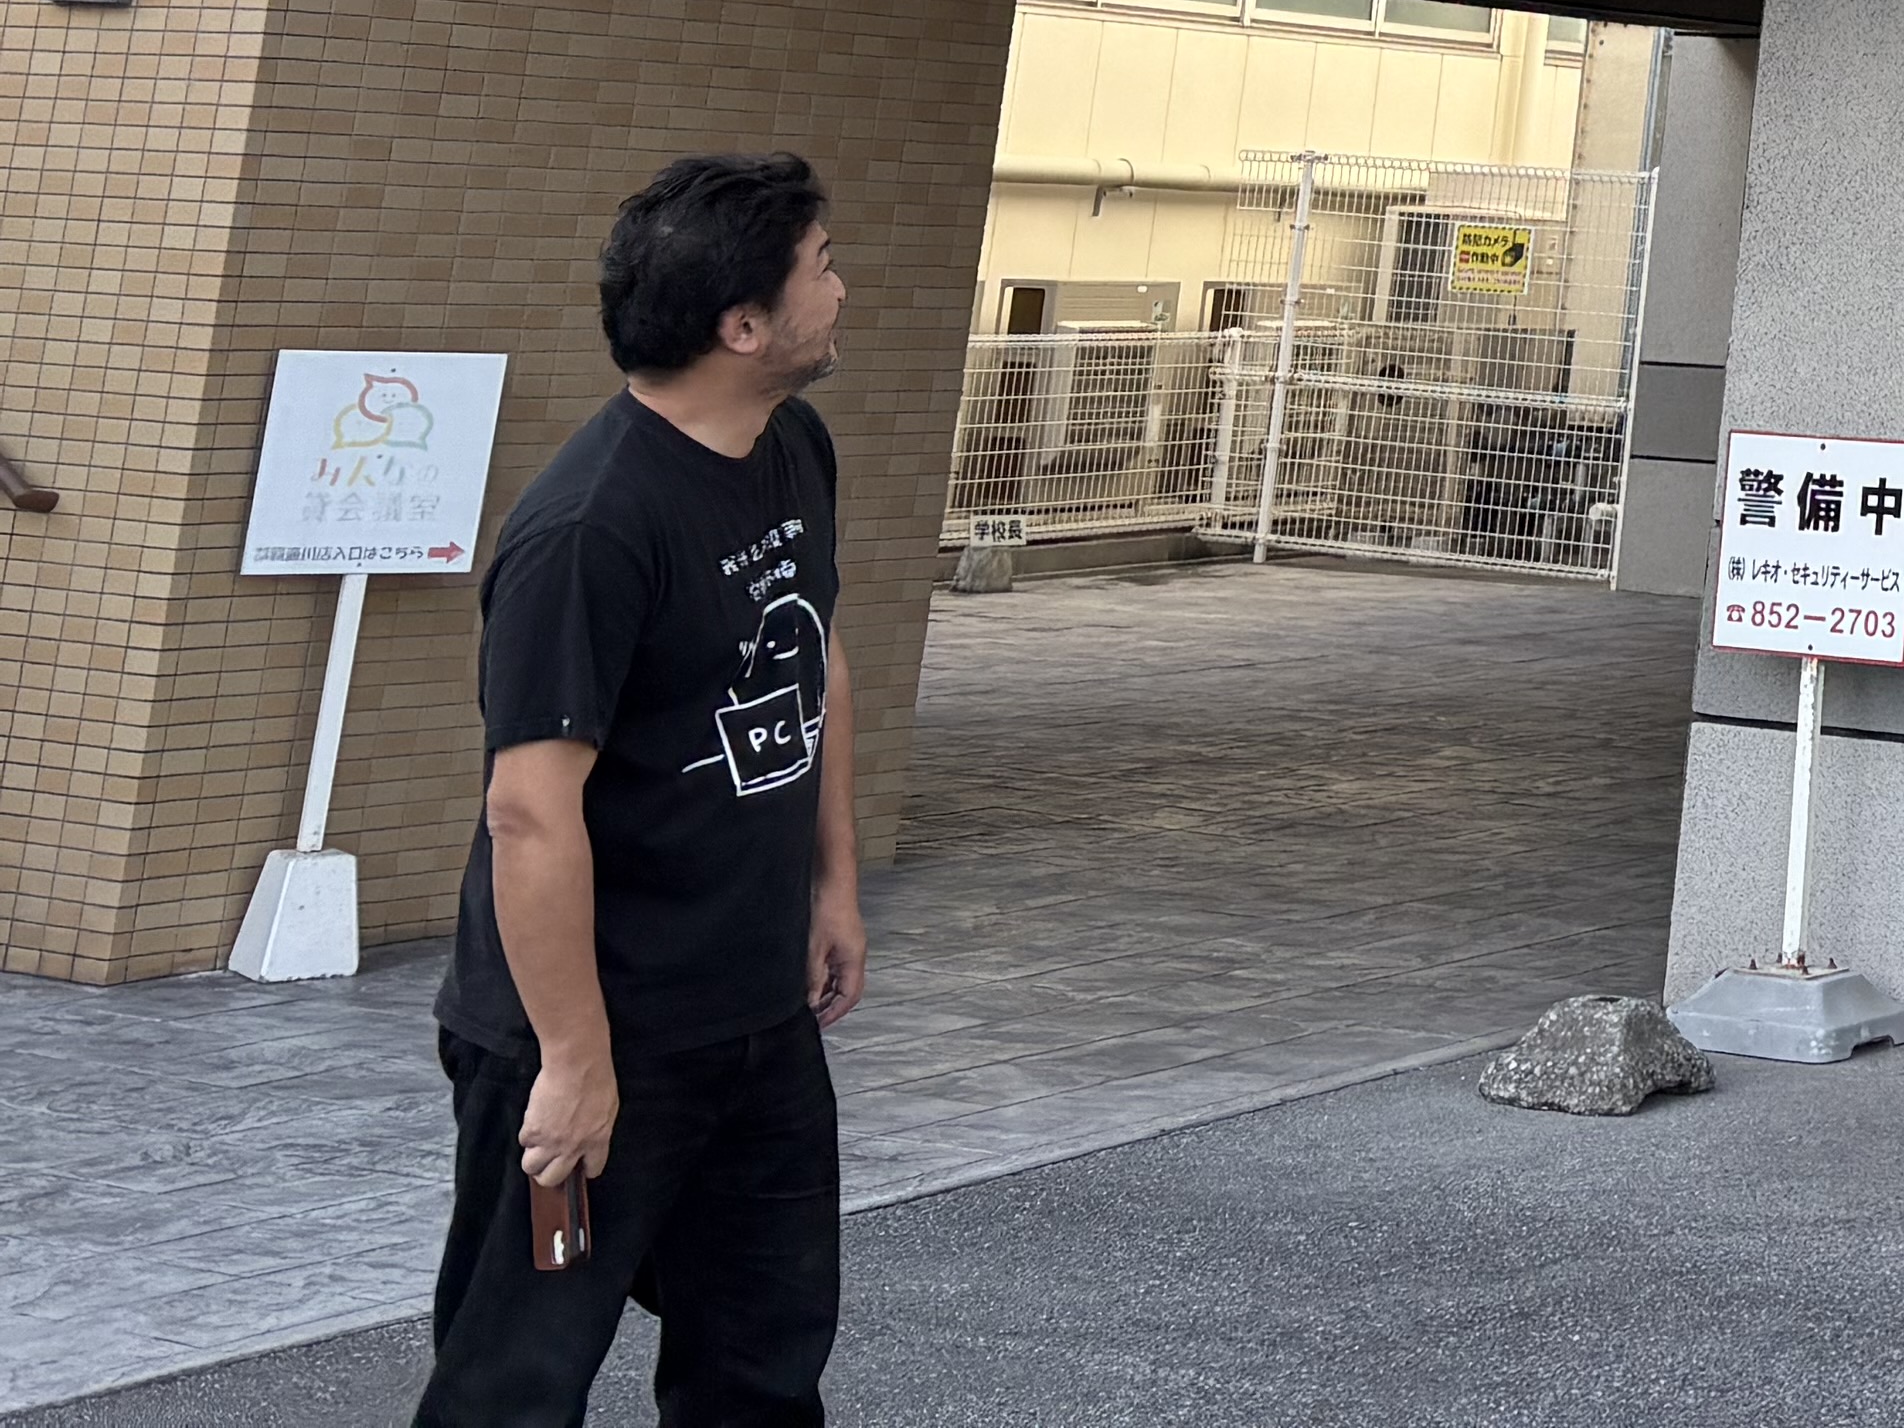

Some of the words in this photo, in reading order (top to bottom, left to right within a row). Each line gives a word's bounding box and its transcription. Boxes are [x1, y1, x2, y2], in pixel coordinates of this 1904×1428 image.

[1736, 467, 1904, 537] 警備中
[974, 519, 1023, 543] 学校長
[748, 720, 792, 753] PC
